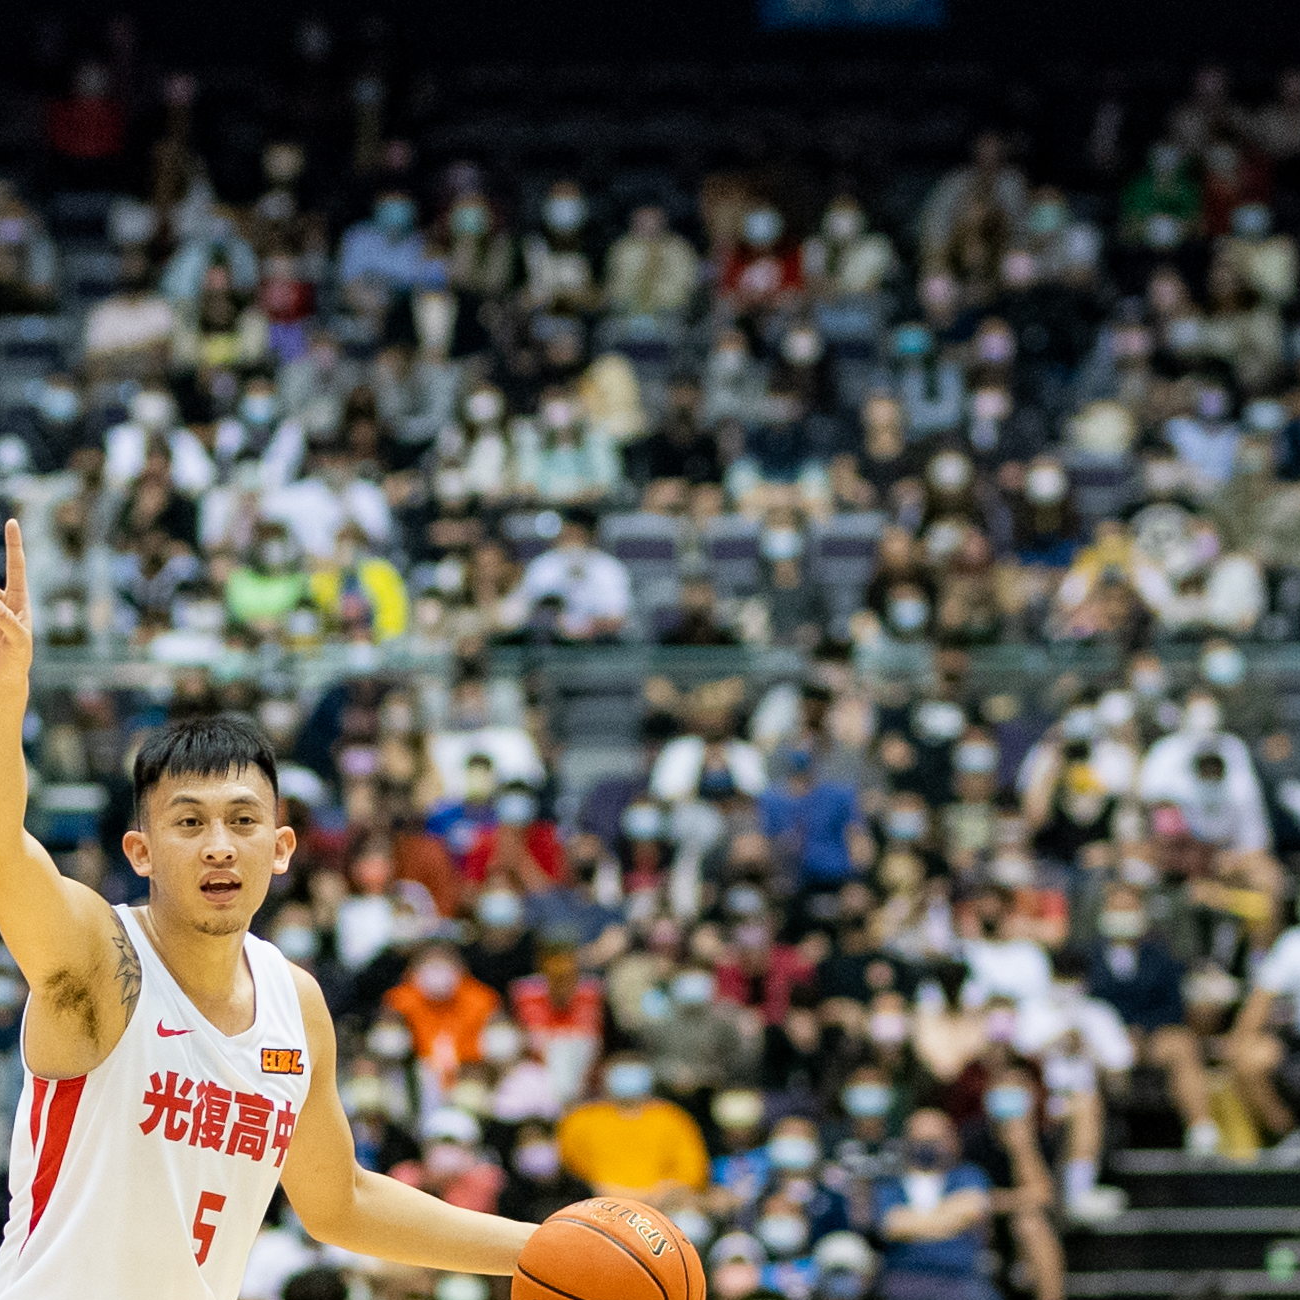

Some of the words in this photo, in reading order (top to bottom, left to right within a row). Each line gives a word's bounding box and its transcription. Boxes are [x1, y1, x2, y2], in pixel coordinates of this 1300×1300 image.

[261, 1048, 304, 1075] HBL
[139, 1070, 296, 1168] 光復高中
[193, 1190, 227, 1268] 5
